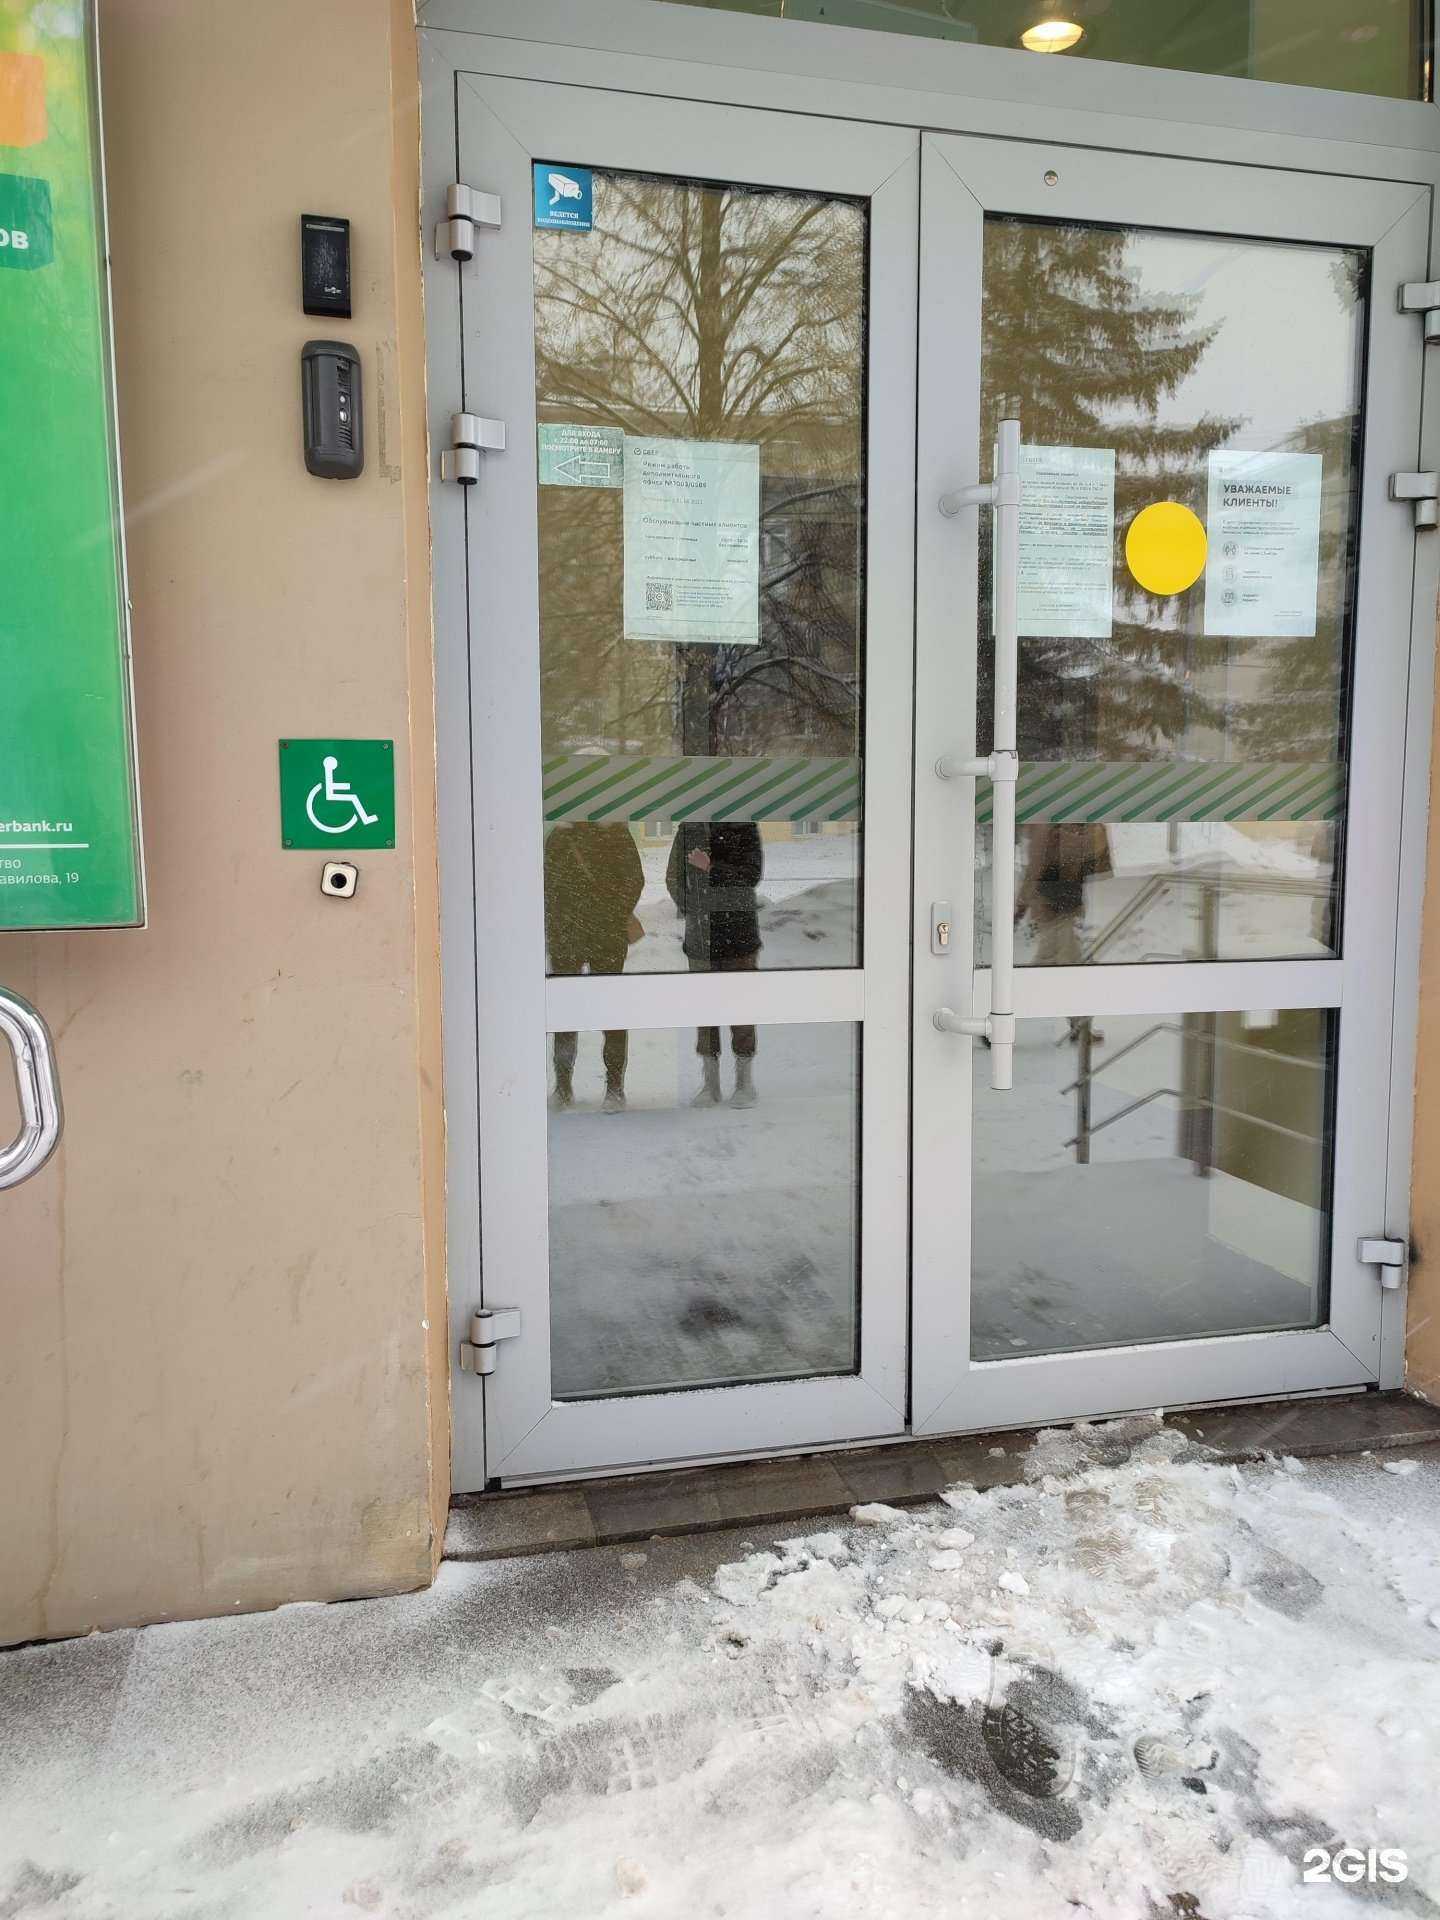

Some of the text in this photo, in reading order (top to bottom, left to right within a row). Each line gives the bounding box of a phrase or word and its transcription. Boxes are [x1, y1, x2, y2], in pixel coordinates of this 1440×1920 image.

[1224, 484, 1292, 495] УВАЖАЕМЫЕ
[1224, 498, 1278, 508] КЛИЕНТЫ!
[65, 872, 79, 884] 19
